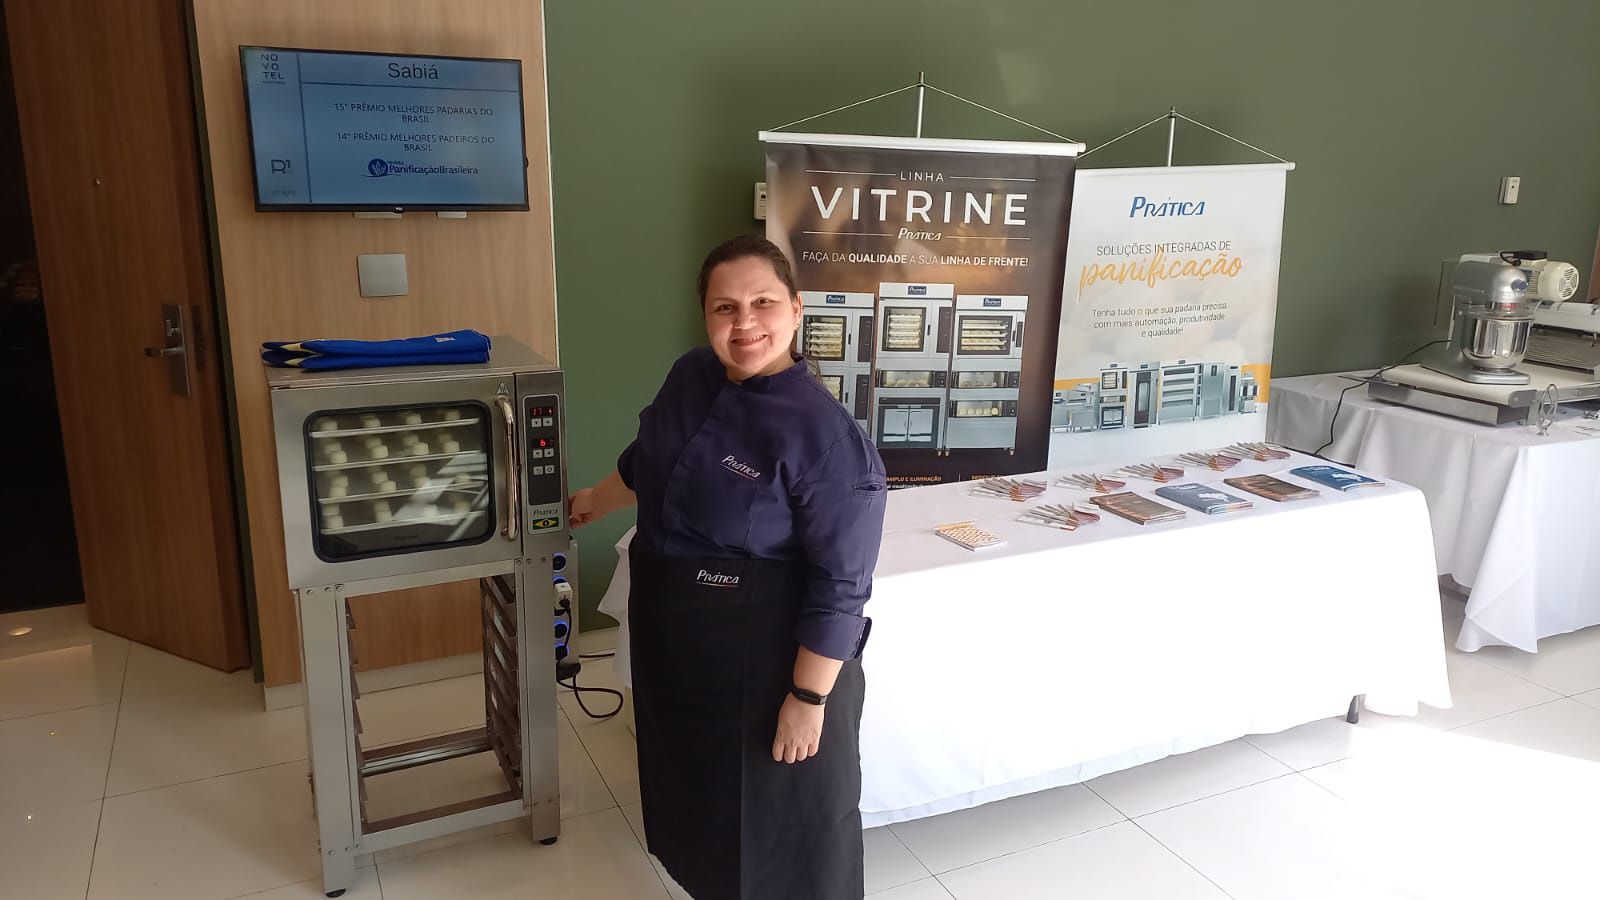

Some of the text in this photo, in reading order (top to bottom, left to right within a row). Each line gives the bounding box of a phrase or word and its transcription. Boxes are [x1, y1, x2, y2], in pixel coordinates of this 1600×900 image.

[262, 71, 284, 79] TEL
[388, 62, 439, 80] Sabiá
[351, 103, 386, 112] PRÊMIO
[388, 105, 434, 114] MELHORES
[437, 106, 477, 115] PADARIAS
[480, 108, 493, 116] DO
[401, 115, 429, 123] BRASIL
[353, 132, 387, 141] PRÊMIO
[390, 134, 436, 143] MELHORES
[439, 135, 479, 144] PADEIROS
[481, 136, 495, 144] DO
[404, 143, 432, 151] BRASIL
[900, 171, 944, 182] LINHA
[811, 186, 1028, 226] VITRINE
[1096, 240, 1232, 257] SOLUÇÕES INTEGRADAS DE
[802, 251, 1029, 267] FAÇA DA QUALIDADE A SUA LINHA DE FRENTE!
[1078, 250, 1243, 292] panificação
[1092, 308, 1116, 317] Tenha
[1118, 308, 1136, 316] tudo
[1144, 308, 1160, 316] que
[1161, 306, 1173, 314] sua
[1175, 304, 1200, 314] padaria
[1202, 302, 1227, 312] precisa
[1093, 320, 1111, 328] com
[1113, 318, 1132, 327] mais
[1179, 312, 1225, 324] produtividade
[1147, 327, 1184, 338] qualidade!
